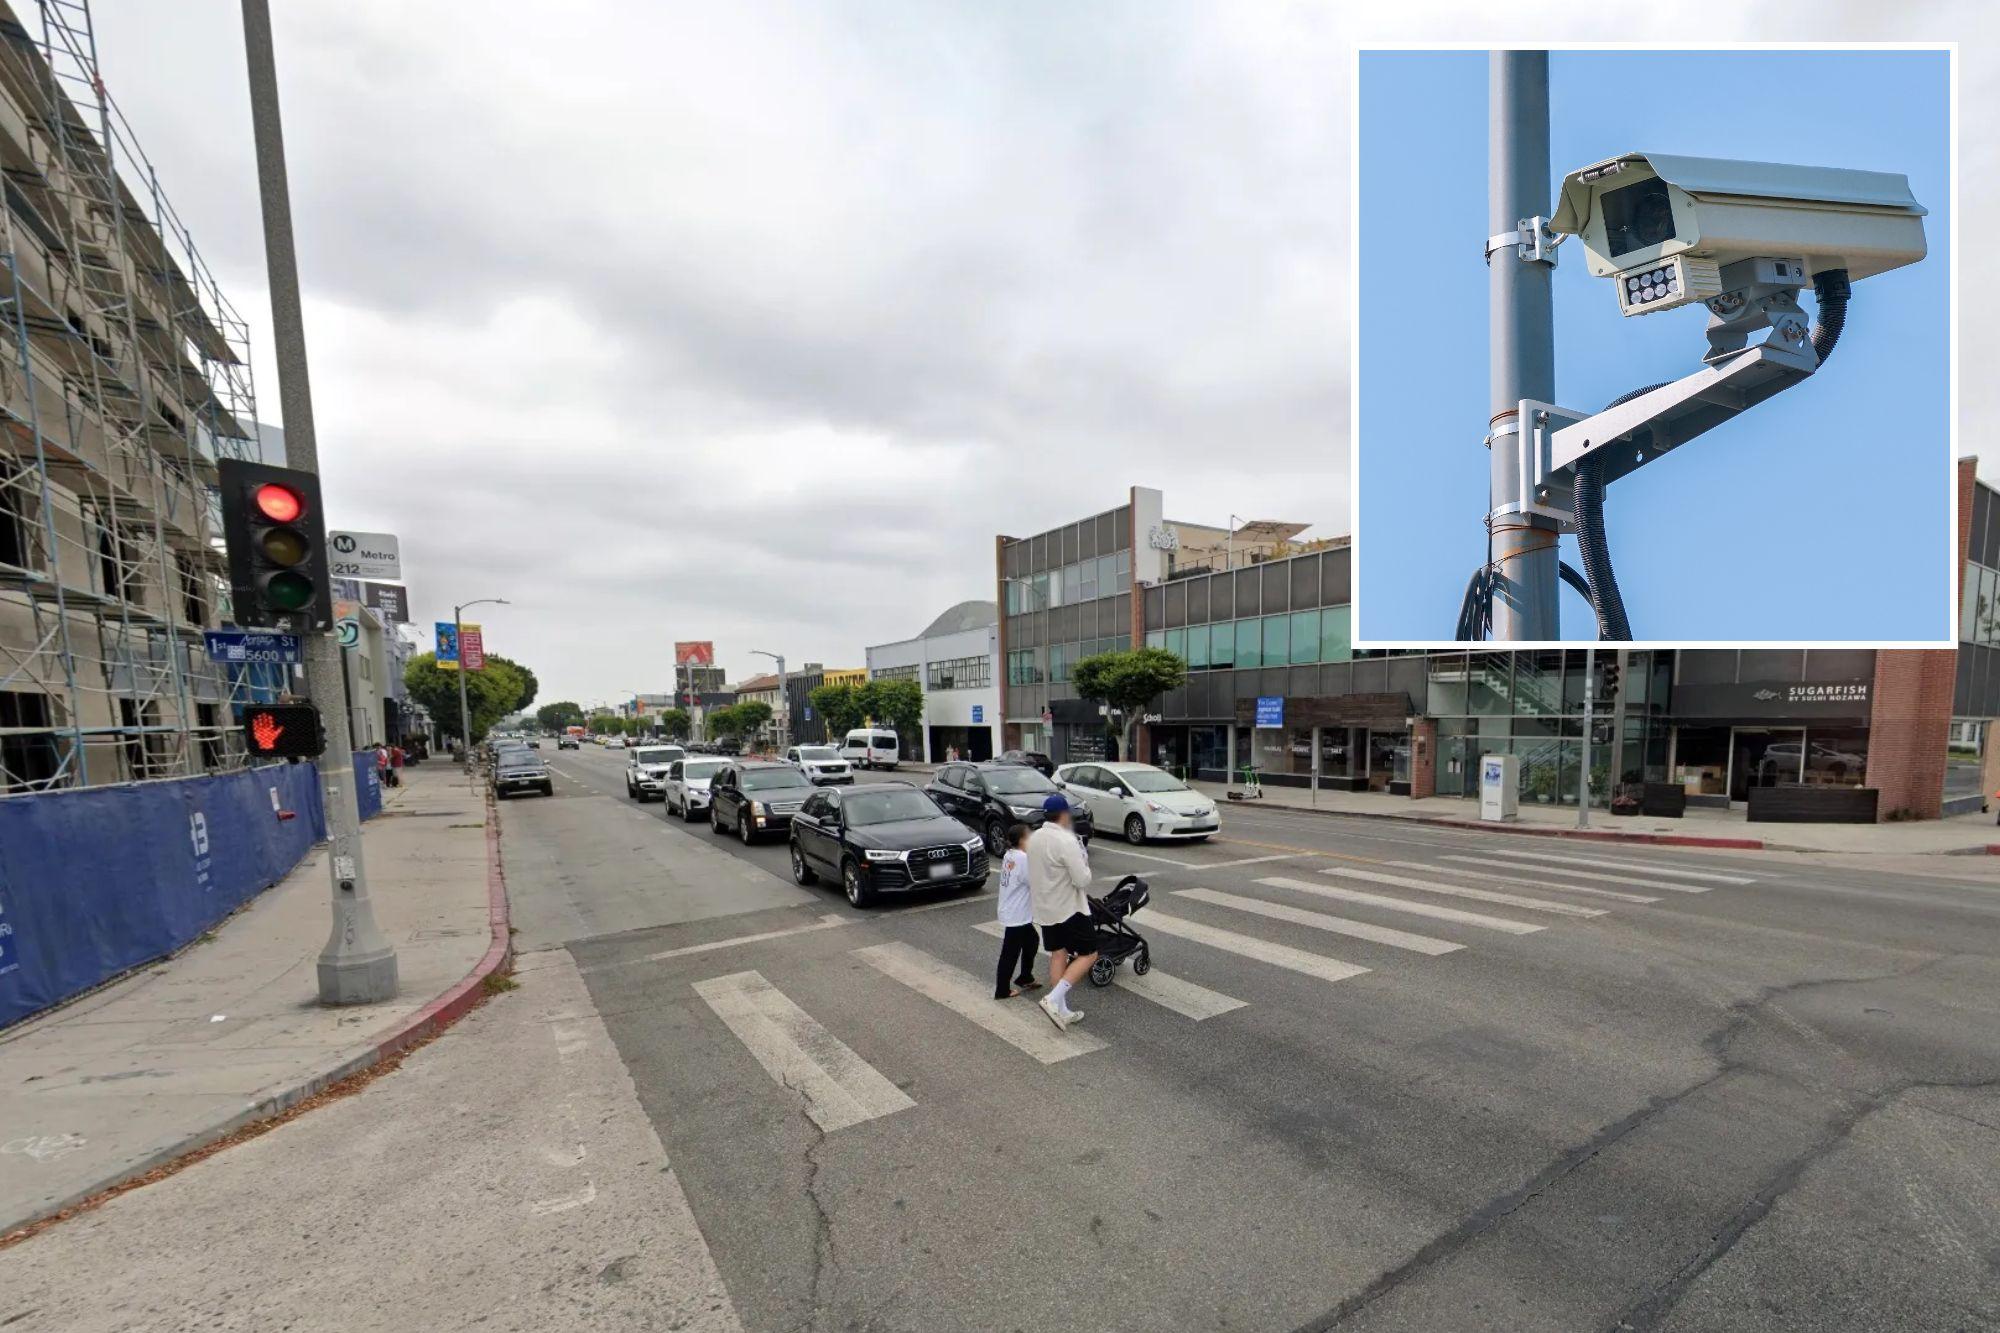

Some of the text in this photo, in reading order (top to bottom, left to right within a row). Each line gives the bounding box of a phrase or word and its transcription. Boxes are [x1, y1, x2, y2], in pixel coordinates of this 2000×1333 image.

[336, 537, 353, 551] M
[360, 550, 396, 561] Metro
[334, 563, 361, 575] 212
[281, 635, 295, 647] St
[246, 650, 296, 661] 5600 W
[1789, 685, 1868, 695] SUGARFISH
[1829, 694, 1867, 702] NOZAWA
